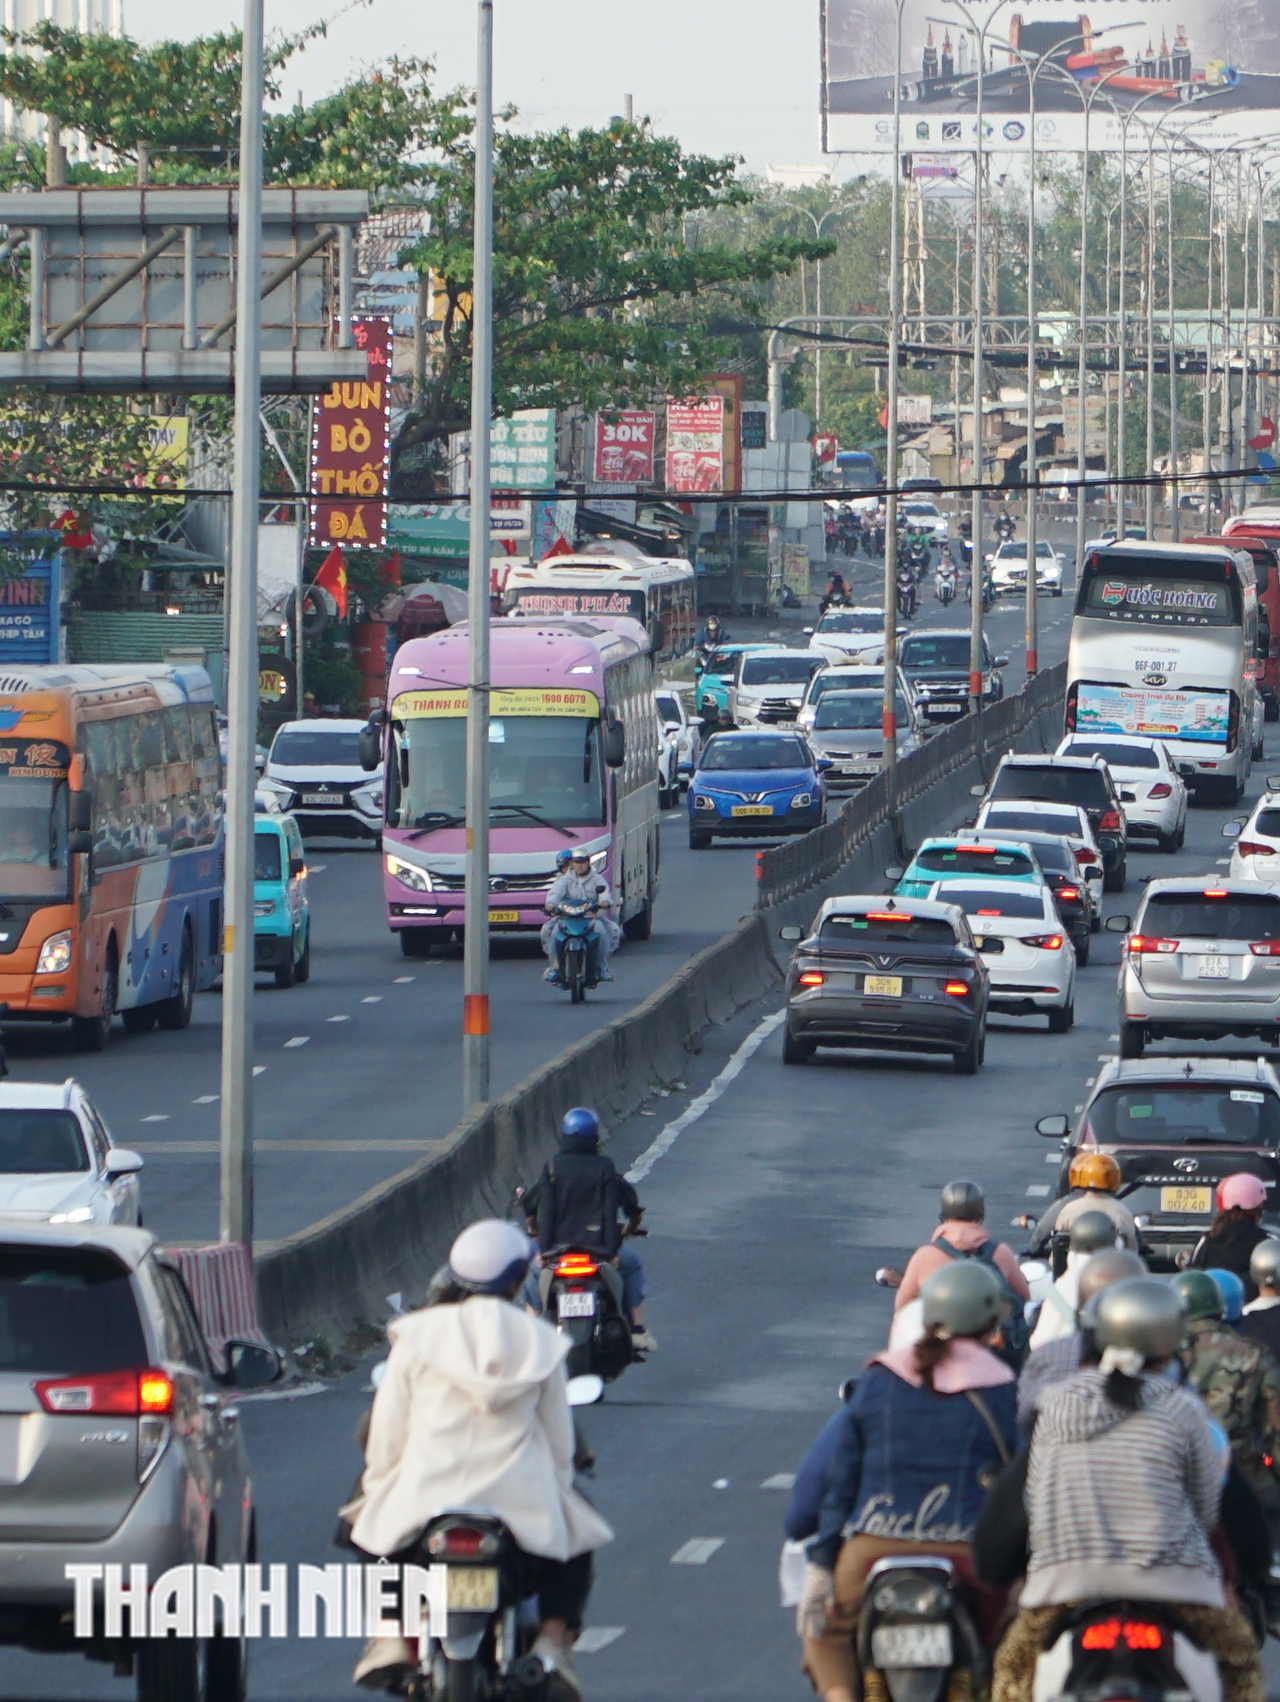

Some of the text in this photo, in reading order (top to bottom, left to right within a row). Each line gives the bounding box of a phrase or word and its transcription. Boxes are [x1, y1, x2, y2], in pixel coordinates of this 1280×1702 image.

[330, 418, 372, 453] BÒ
[602, 424, 648, 443] 30K
[318, 462, 384, 498] THỐ
[329, 504, 368, 540] ĐÁ
[519, 592, 632, 615] THỊNH PHÁT
[412, 697, 451, 711] THÀNH
